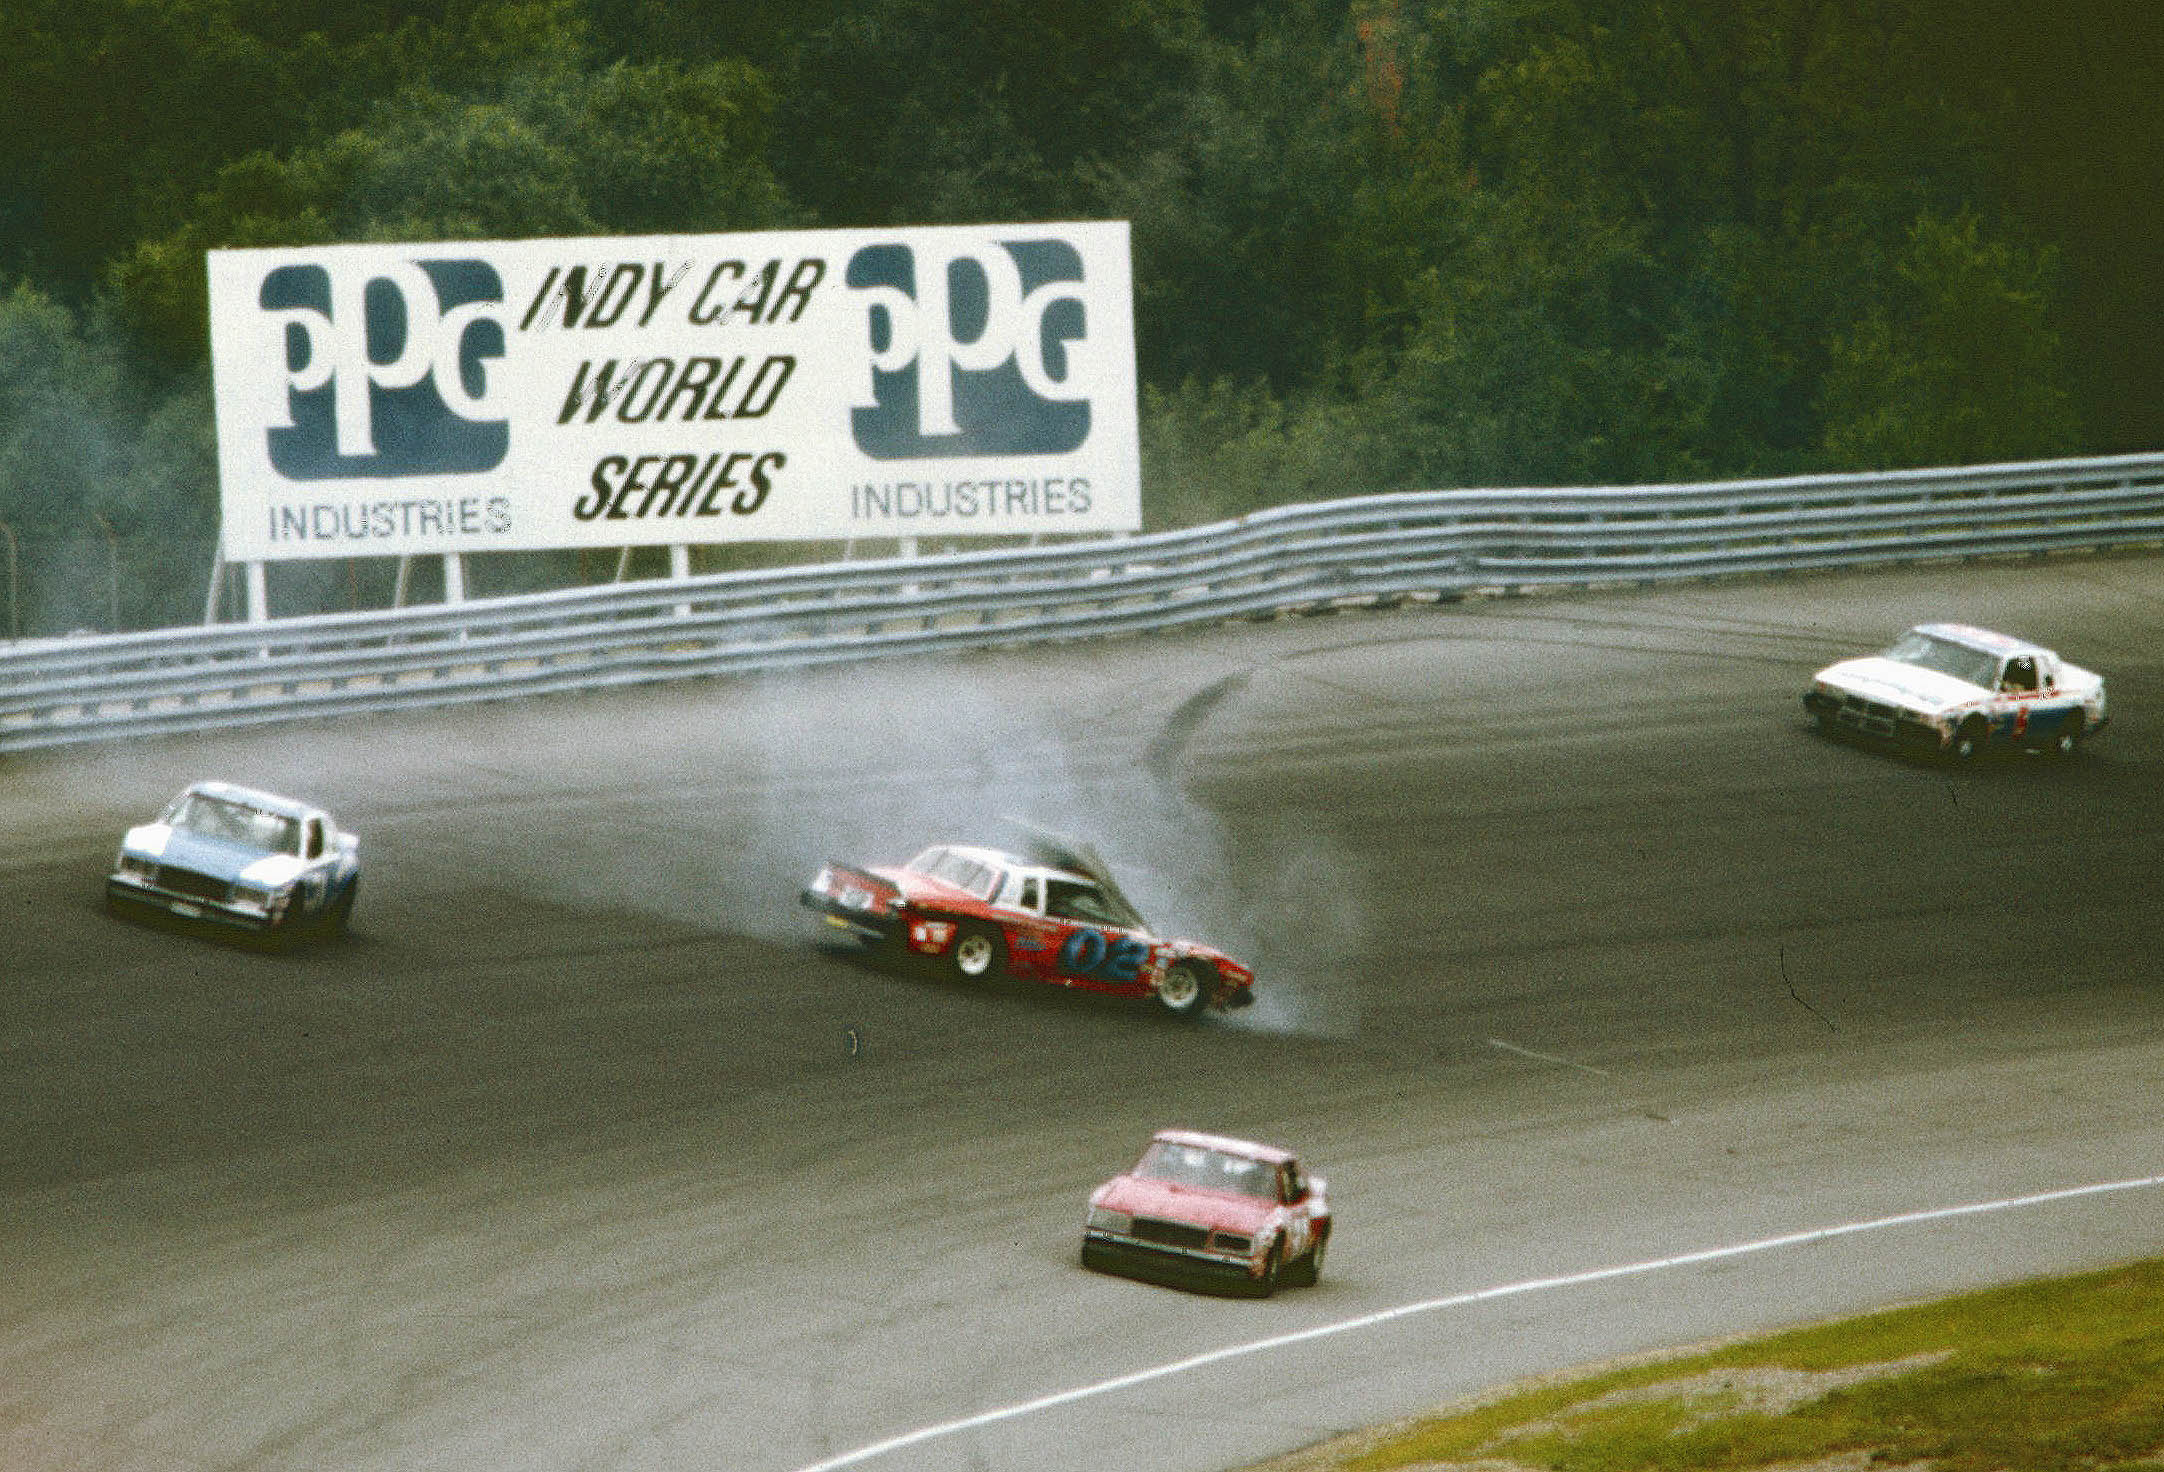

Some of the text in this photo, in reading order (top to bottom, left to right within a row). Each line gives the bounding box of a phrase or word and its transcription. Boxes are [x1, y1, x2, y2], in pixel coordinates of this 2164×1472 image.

[519, 258, 827, 331] INDY CAR
[556, 354, 797, 425] WORLD
[269, 497, 512, 540] INDUSTRIES
[573, 451, 788, 521] SERIES
[852, 478, 1093, 518] INDUSTRIES
